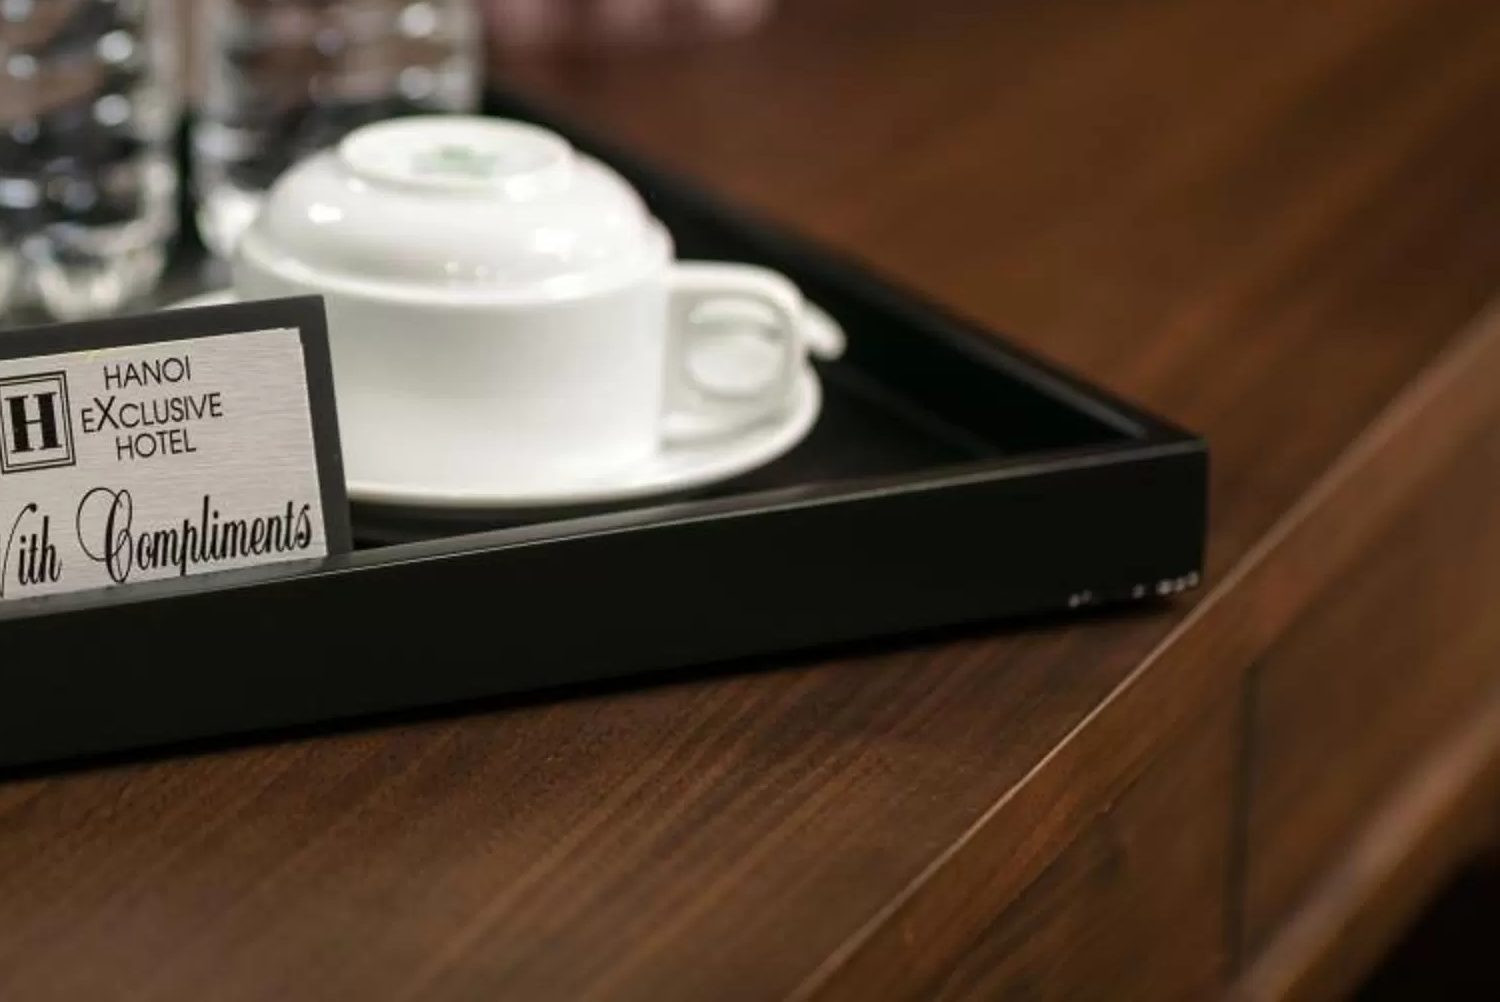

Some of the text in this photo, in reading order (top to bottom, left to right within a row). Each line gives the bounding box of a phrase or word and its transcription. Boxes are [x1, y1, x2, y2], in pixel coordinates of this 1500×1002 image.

[104, 356, 191, 389] HANOI
[5, 392, 62, 453] H
[82, 393, 223, 432] EXCLUSIVE
[116, 429, 197, 460] HOTEL
[76, 487, 311, 582] Compliments
